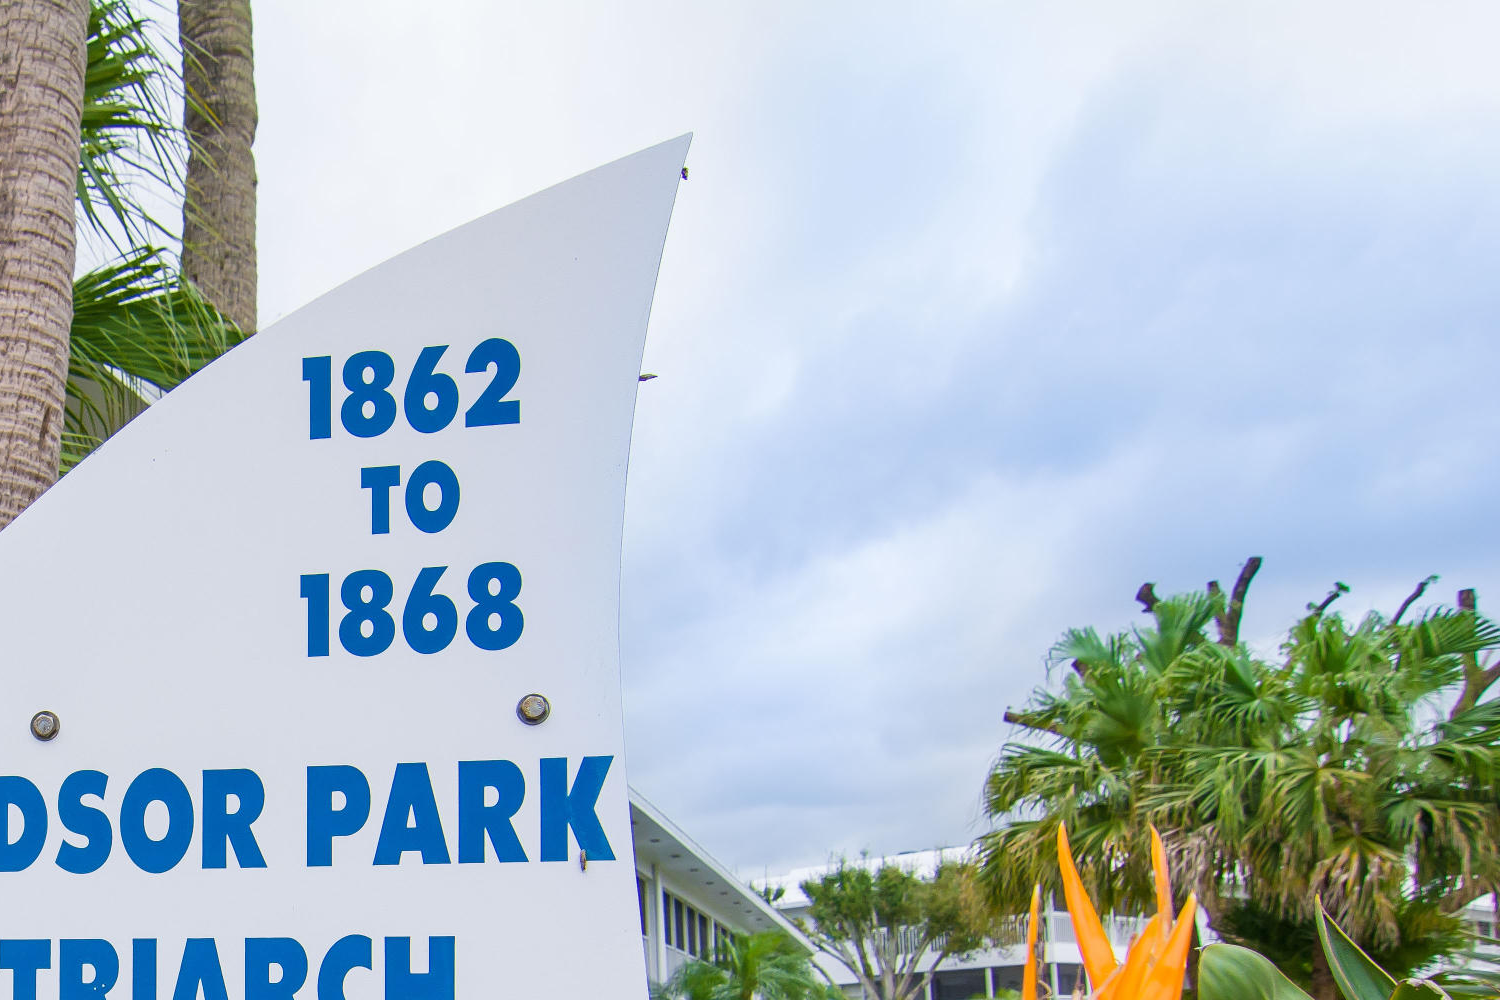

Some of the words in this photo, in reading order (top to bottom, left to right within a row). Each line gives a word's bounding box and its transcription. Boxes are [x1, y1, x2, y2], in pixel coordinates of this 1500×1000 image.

[302, 338, 521, 441] 1862
[360, 460, 461, 535] TO
[299, 561, 524, 658] 1868
[306, 755, 616, 867] PARK
